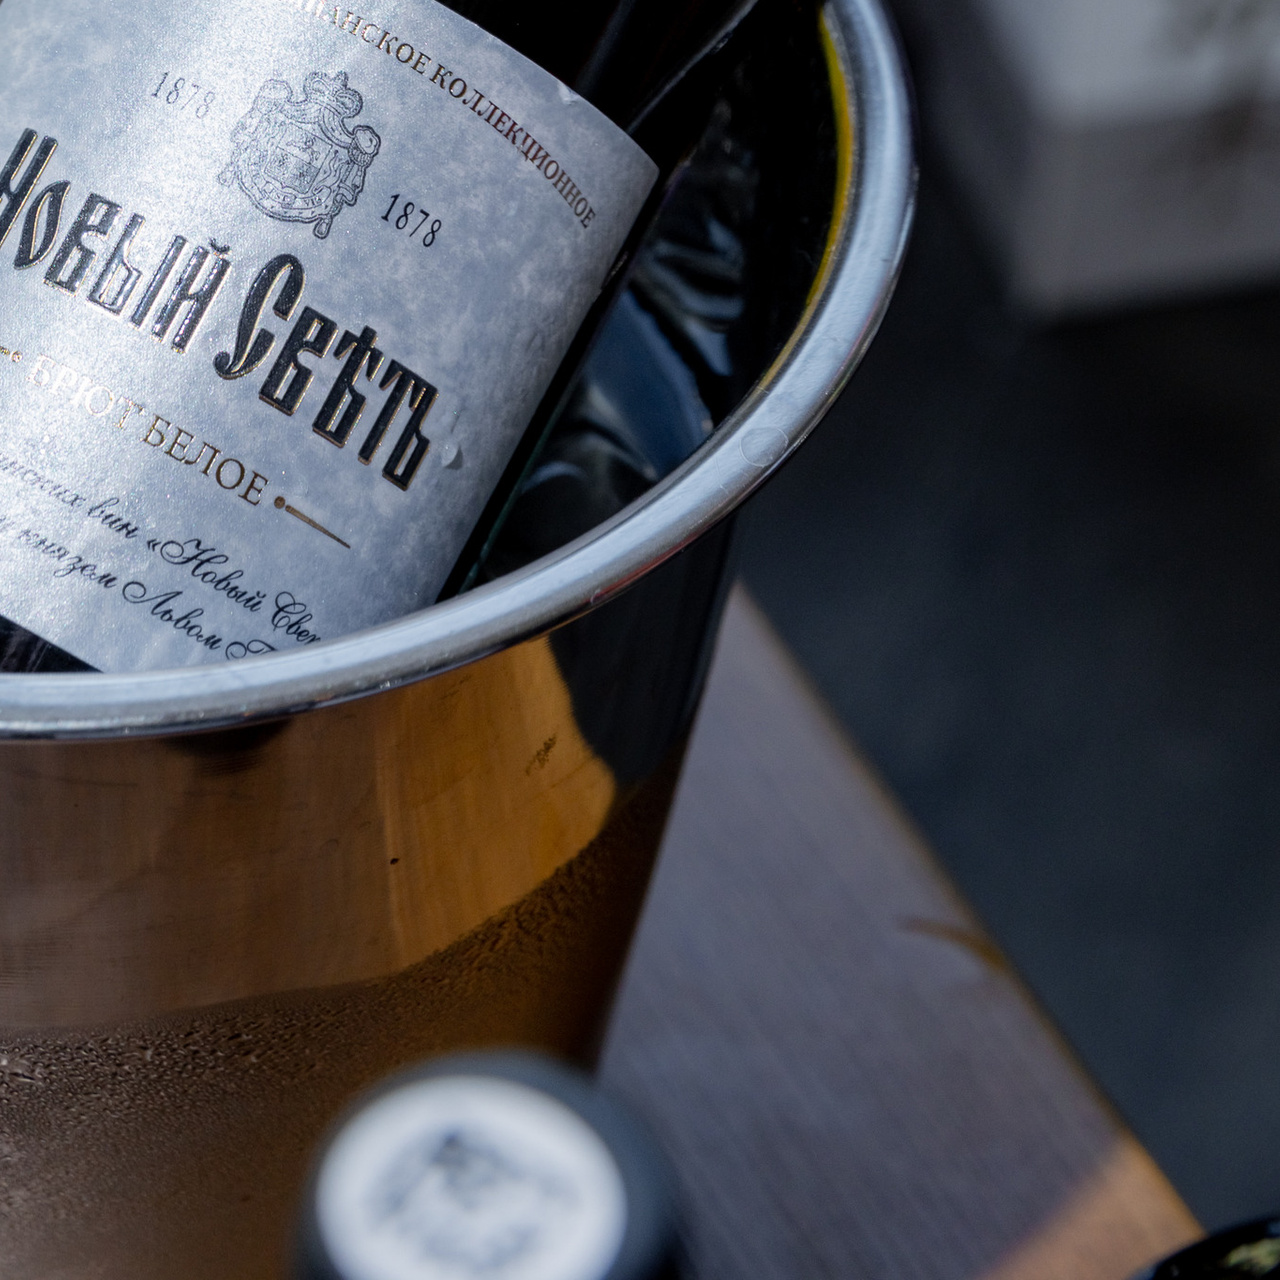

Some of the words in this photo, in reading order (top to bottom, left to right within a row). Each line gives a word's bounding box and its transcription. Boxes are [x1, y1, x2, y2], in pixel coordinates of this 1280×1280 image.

[151, 70, 216, 119] 1878
[428, 62, 597, 229] КОЛЛЕКЦИОННОЕ
[380, 193, 442, 248] 1878
[25, 354, 146, 430] БРЮТ
[140, 414, 269, 507] БЕЛОЕ
[18, 528, 118, 589] князем
[122, 580, 223, 650] Львом
[87, 496, 140, 539] вин
[146, 538, 267, 613] «Новый
